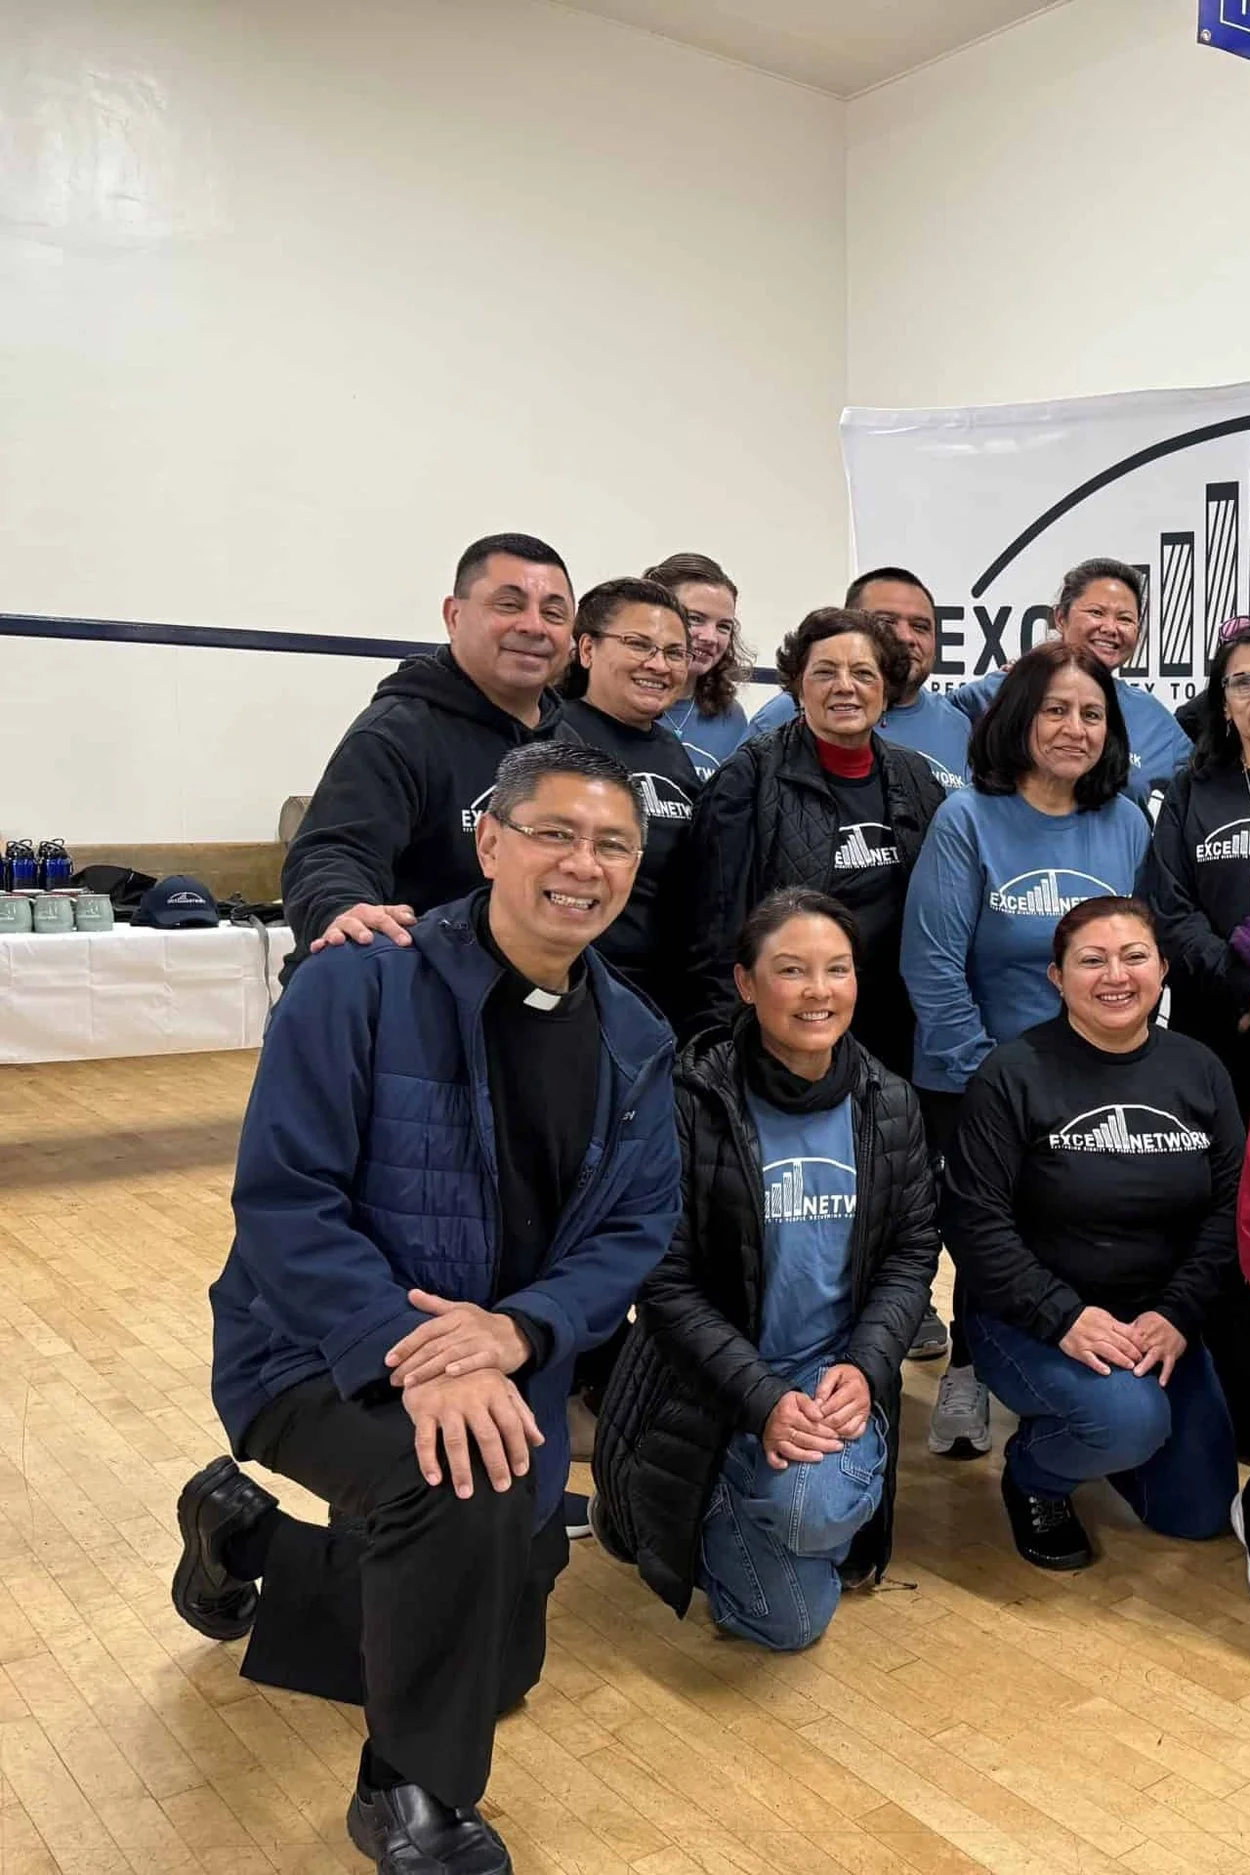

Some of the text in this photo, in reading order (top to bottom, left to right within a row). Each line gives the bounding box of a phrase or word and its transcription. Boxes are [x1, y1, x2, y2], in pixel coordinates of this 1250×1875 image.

[1170, 683, 1196, 700] TO
[1129, 1132, 1211, 1150] NETWORK
[803, 1194, 857, 1215] NETW
